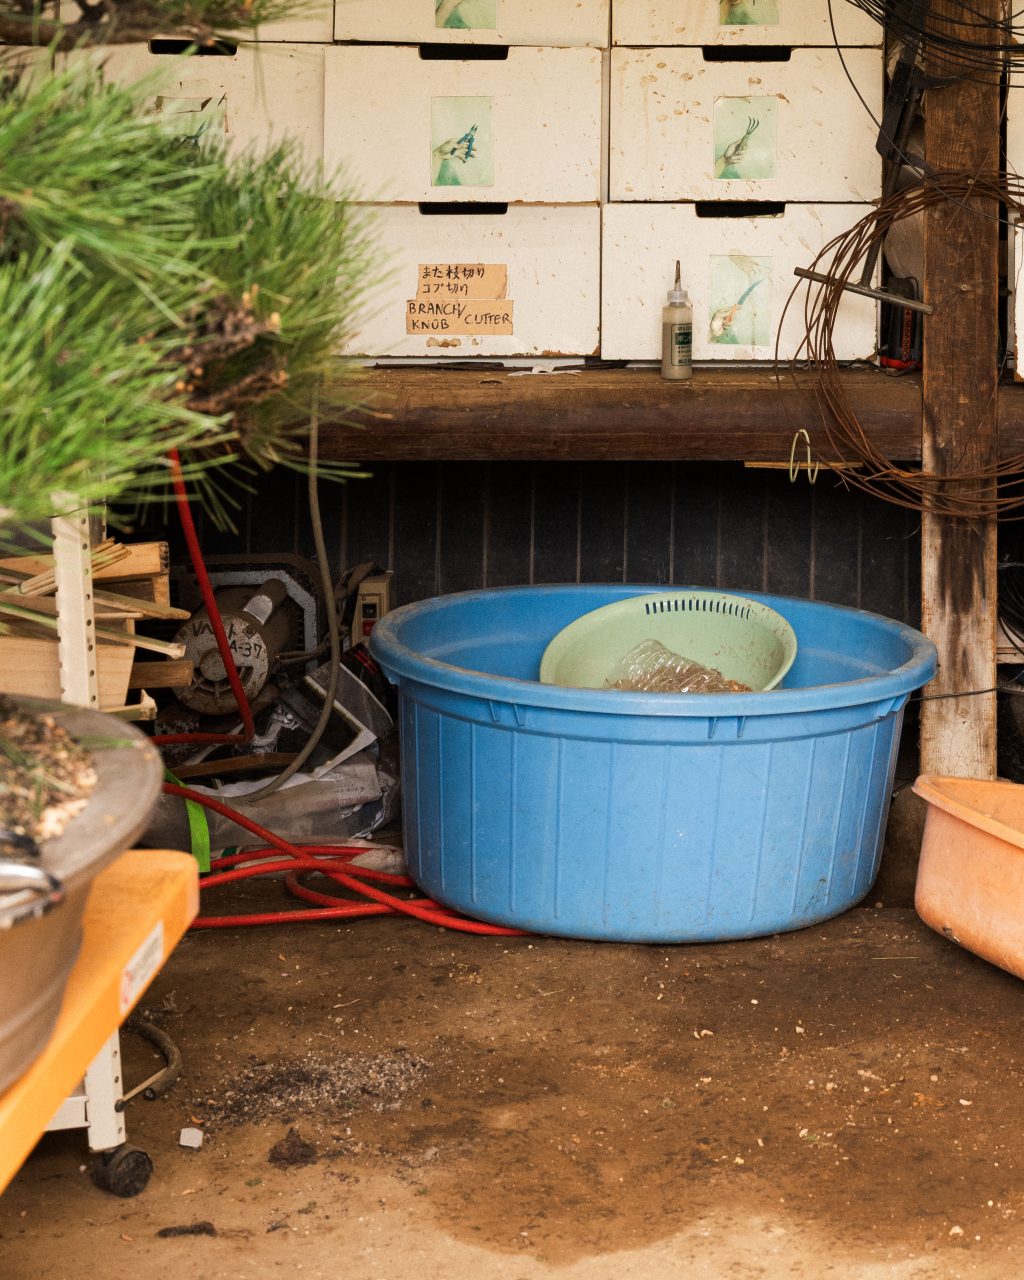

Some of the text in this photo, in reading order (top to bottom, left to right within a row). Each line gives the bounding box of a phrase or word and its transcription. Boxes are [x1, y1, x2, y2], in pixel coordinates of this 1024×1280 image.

[422, 265, 485, 280] また枝切り
[422, 281, 468, 296] コブ切り
[412, 318, 450, 330] KNOB
[464, 312, 513, 325] CUTTER
